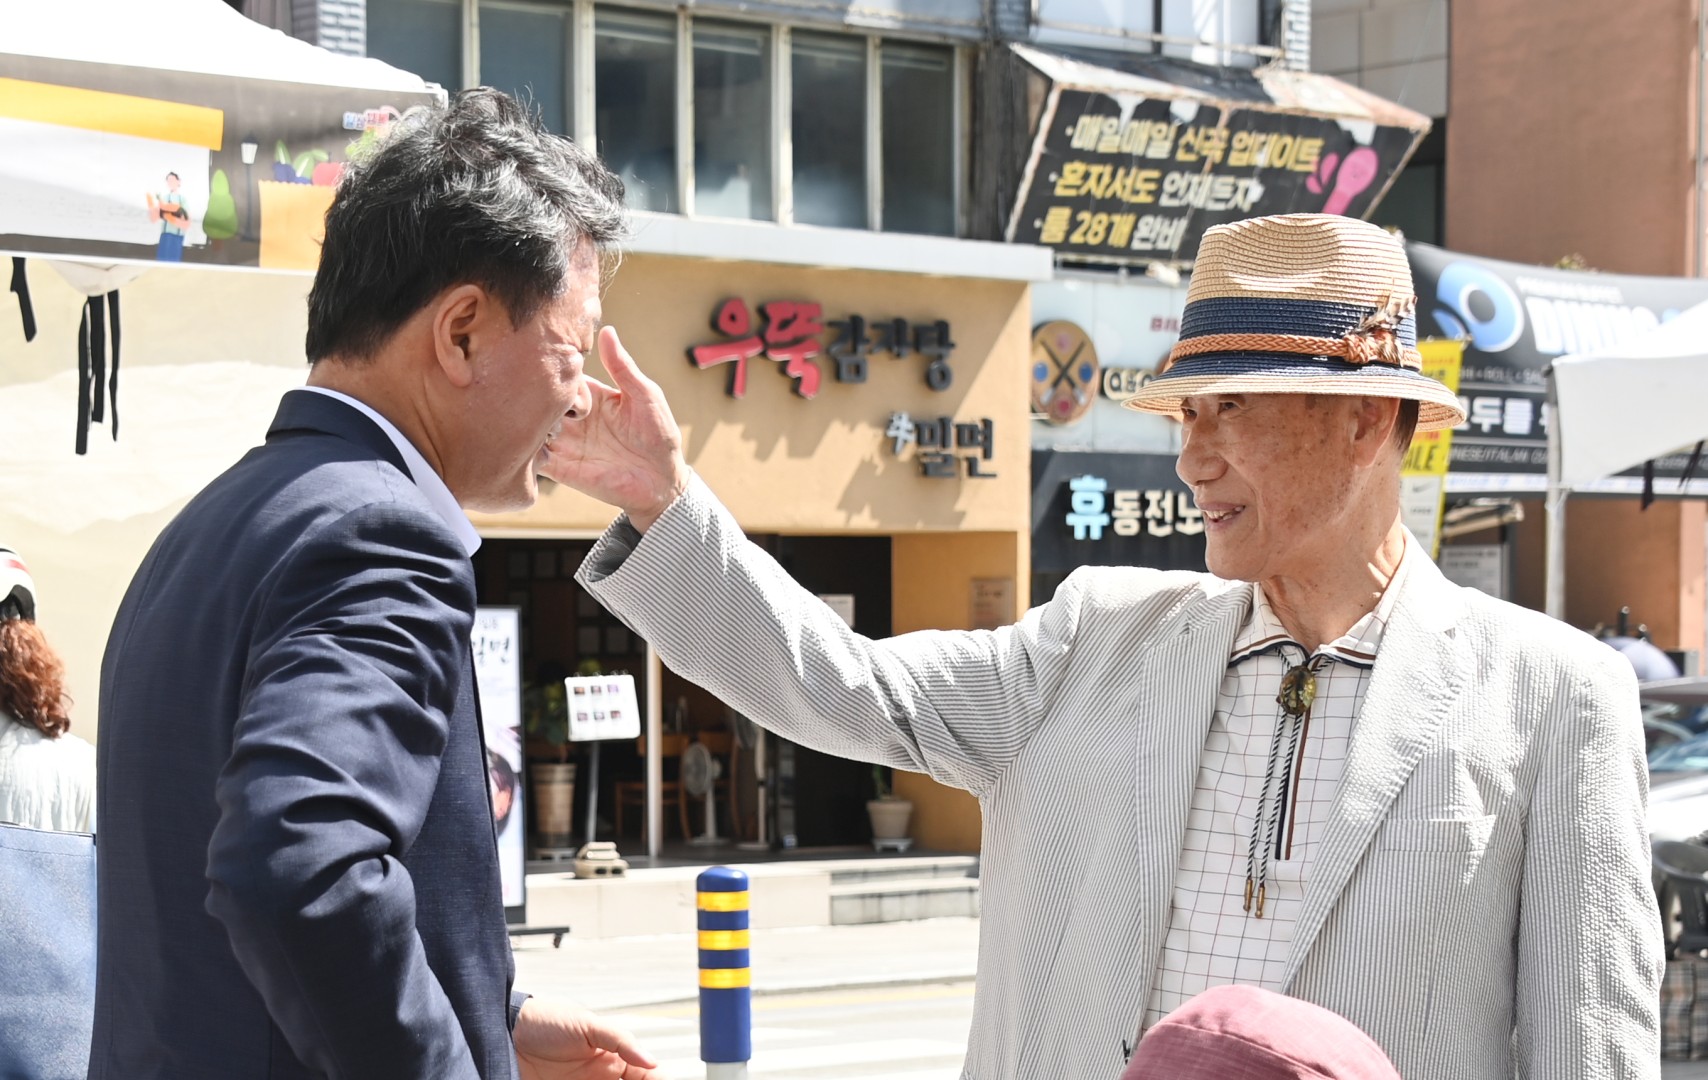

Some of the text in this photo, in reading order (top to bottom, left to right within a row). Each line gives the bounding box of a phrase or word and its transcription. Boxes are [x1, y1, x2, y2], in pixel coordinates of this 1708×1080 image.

[1070, 115, 1176, 159] 매일매일
[1227, 131, 1325, 172] 업데이트
[1053, 160, 1162, 204] 혼자서도
[1068, 211, 1137, 249] 28개
[1130, 214, 1188, 251] 완비
[1065, 474, 1110, 541] 휴
